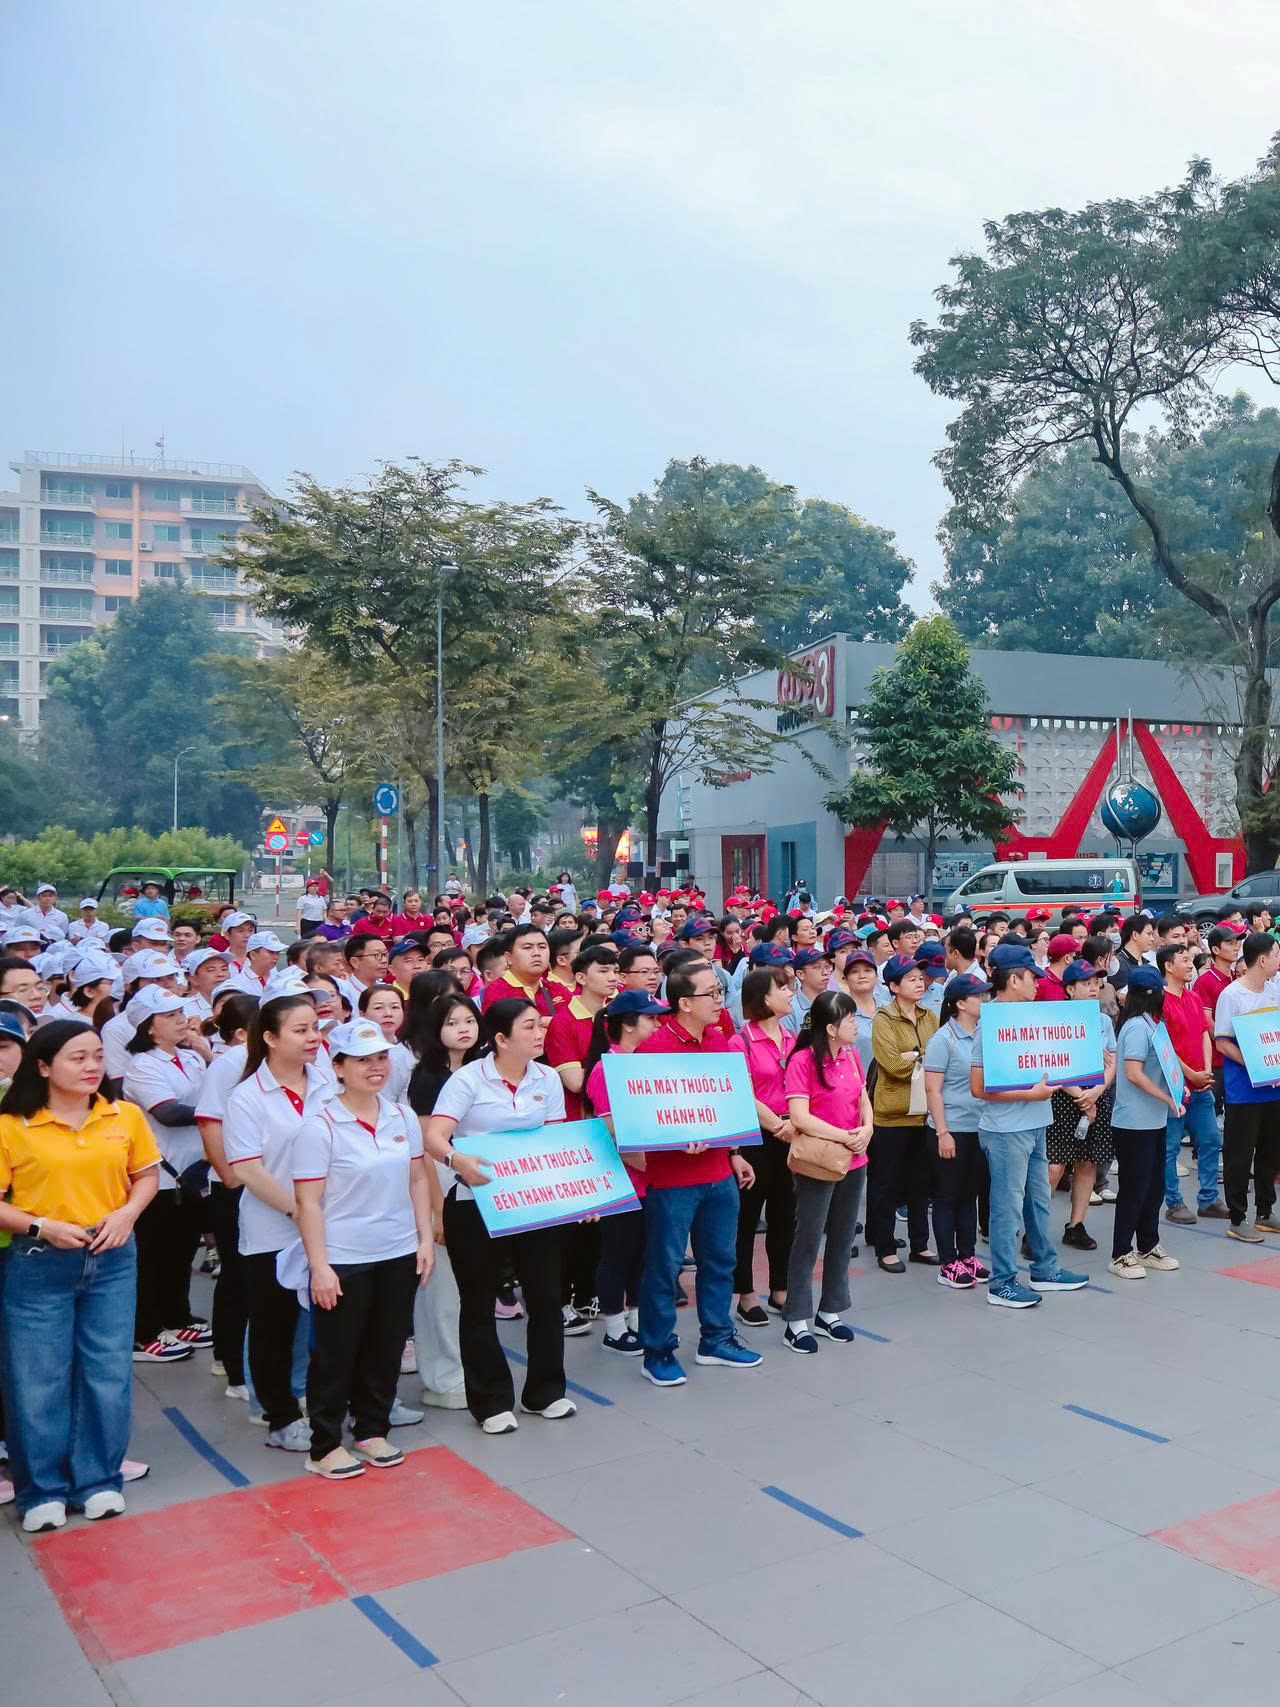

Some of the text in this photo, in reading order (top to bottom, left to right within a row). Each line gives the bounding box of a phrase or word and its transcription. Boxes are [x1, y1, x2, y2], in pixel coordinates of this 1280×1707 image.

[997, 1021, 1086, 1042] NHÀ MÁY THUỐC LÁ
[1018, 1050, 1070, 1069] BẾN THÀNH
[627, 1072, 733, 1095] NHÀ MÁY THUỐC LÁ
[656, 1105, 718, 1126] KHÁNH HỘI
[493, 1144, 594, 1178] NHÀ MÁY THUỐC LÁ
[492, 1188, 519, 1211] BẾN
[517, 1183, 557, 1206] THÀNH
[554, 1177, 598, 1199] CRAVEN
